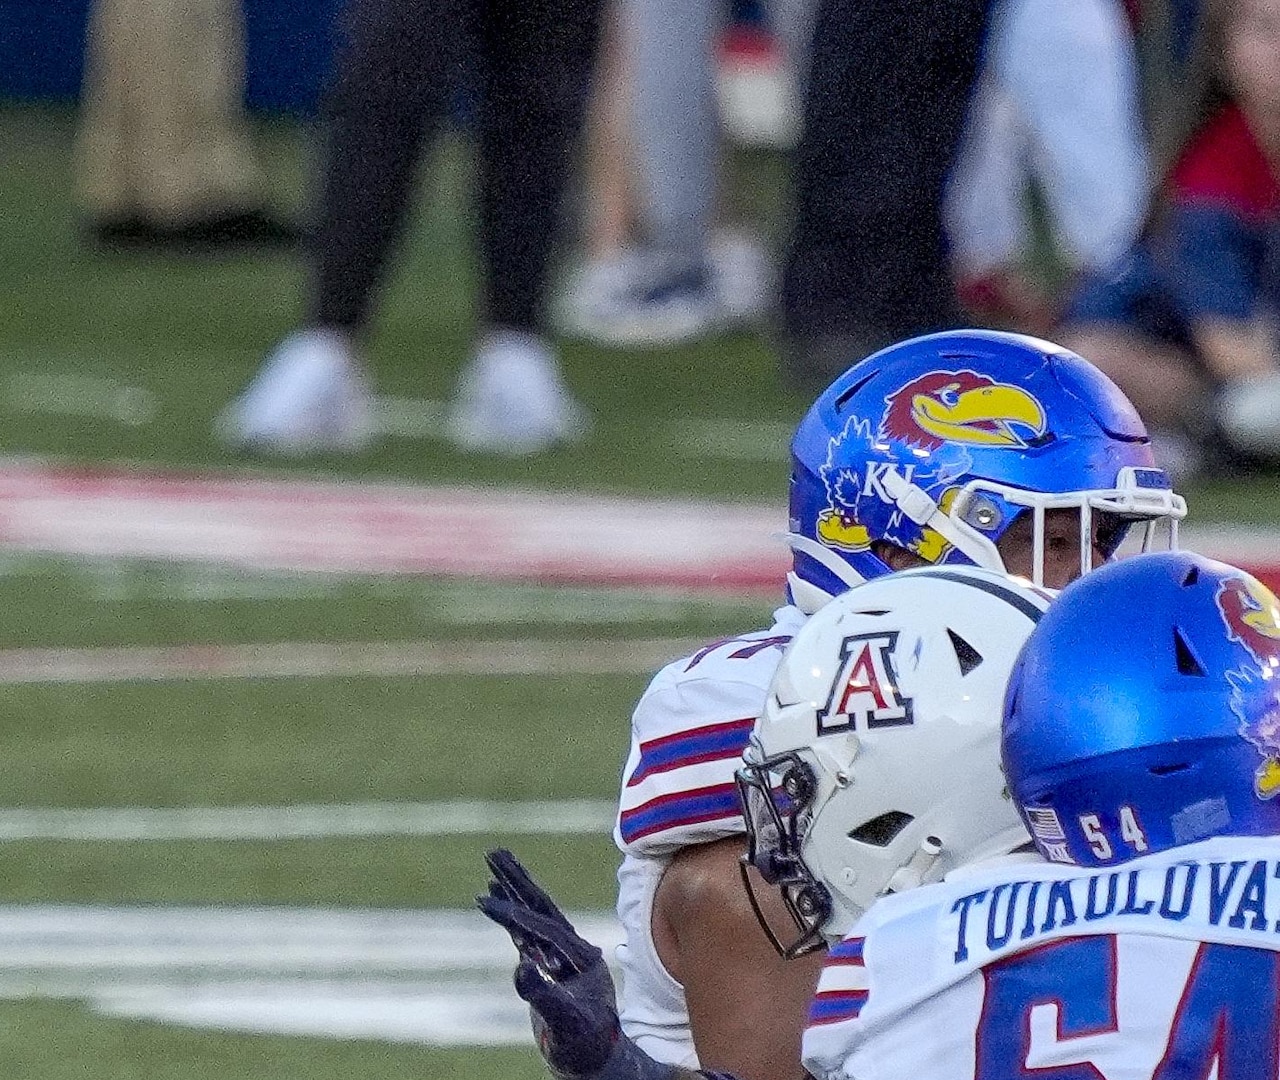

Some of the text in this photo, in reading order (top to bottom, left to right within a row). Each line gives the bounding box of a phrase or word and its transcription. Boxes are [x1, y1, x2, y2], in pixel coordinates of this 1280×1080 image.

[816, 630, 914, 738] A
[1079, 806, 1149, 860] 54
[950, 860, 1280, 964] TUIKOLOVA
